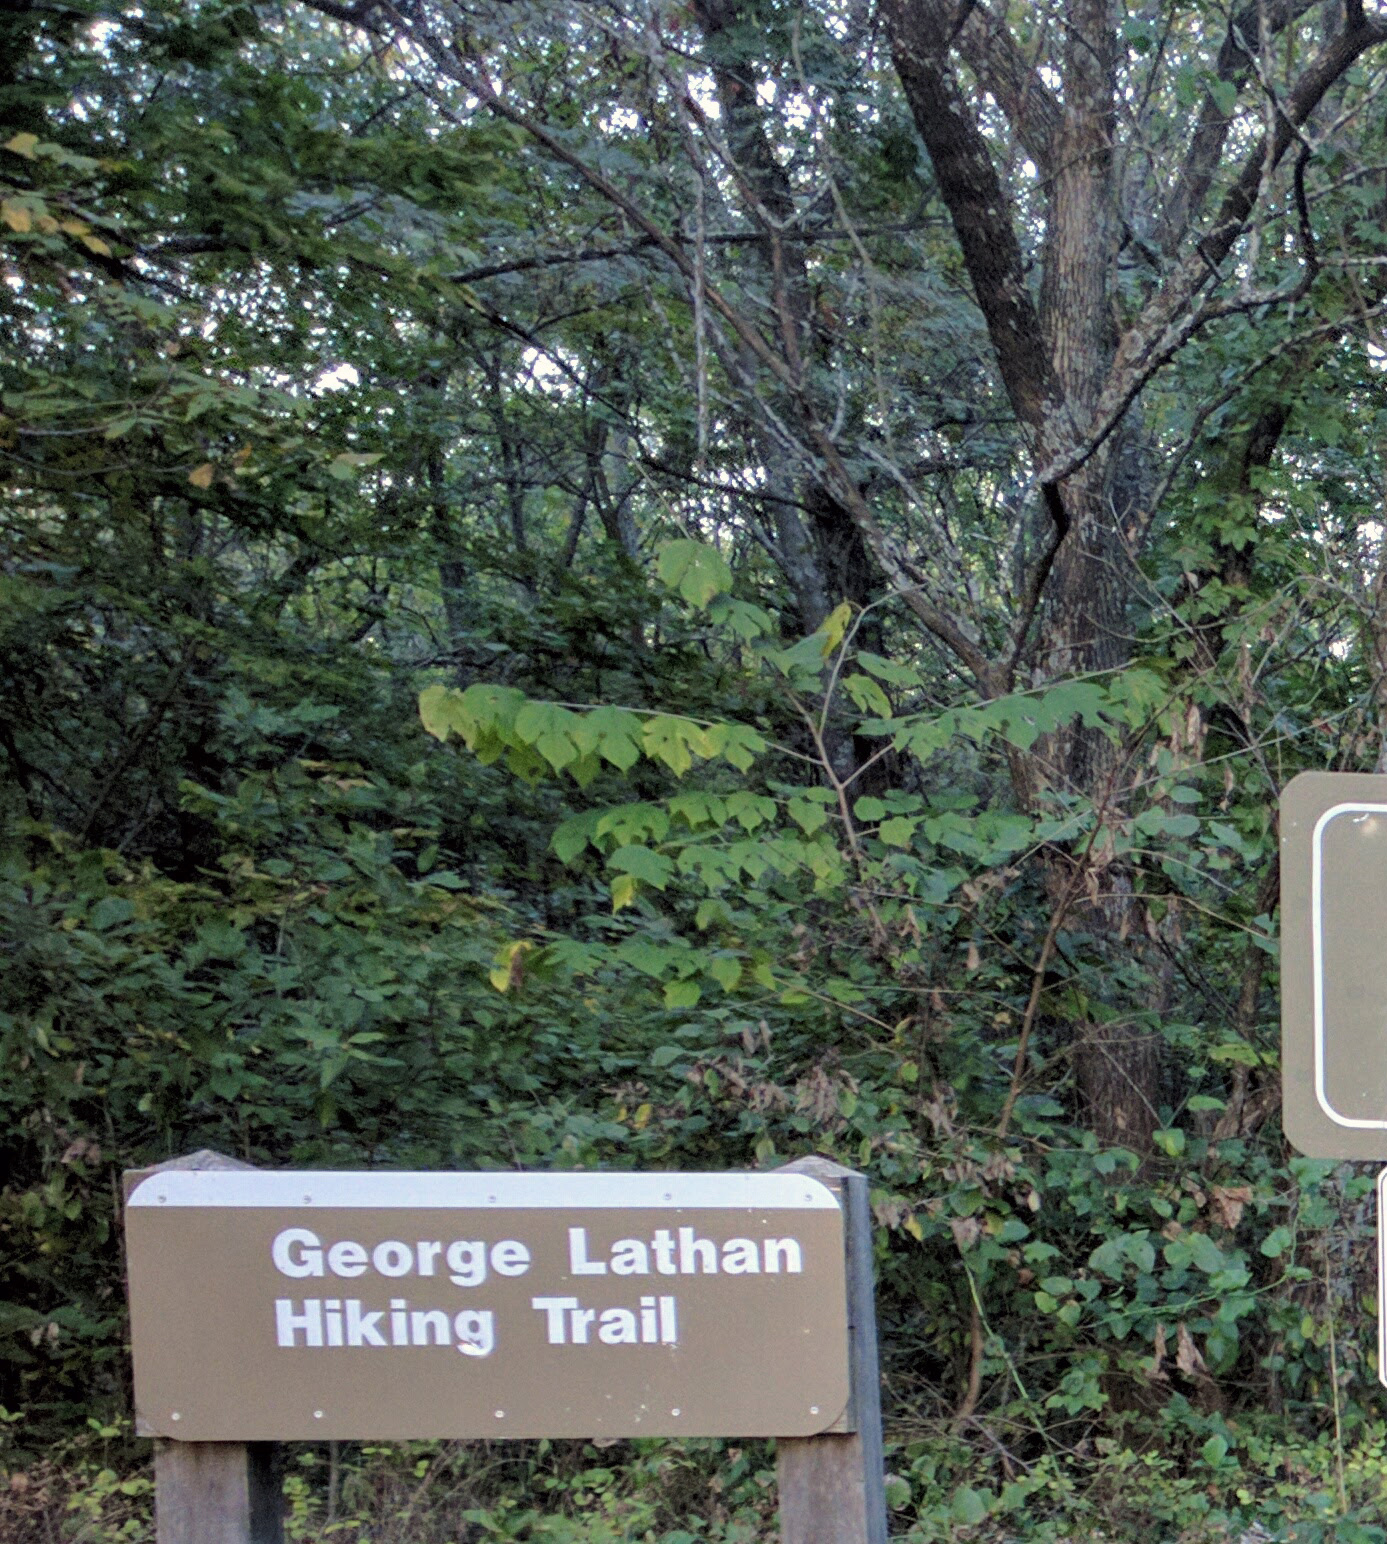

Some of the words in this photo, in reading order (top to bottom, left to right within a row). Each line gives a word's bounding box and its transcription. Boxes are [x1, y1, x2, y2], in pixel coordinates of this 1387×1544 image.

[272, 1227, 531, 1286] George
[569, 1226, 804, 1275] Lathan
[276, 1297, 494, 1356] Hiking
[532, 1296, 676, 1344] Trail
